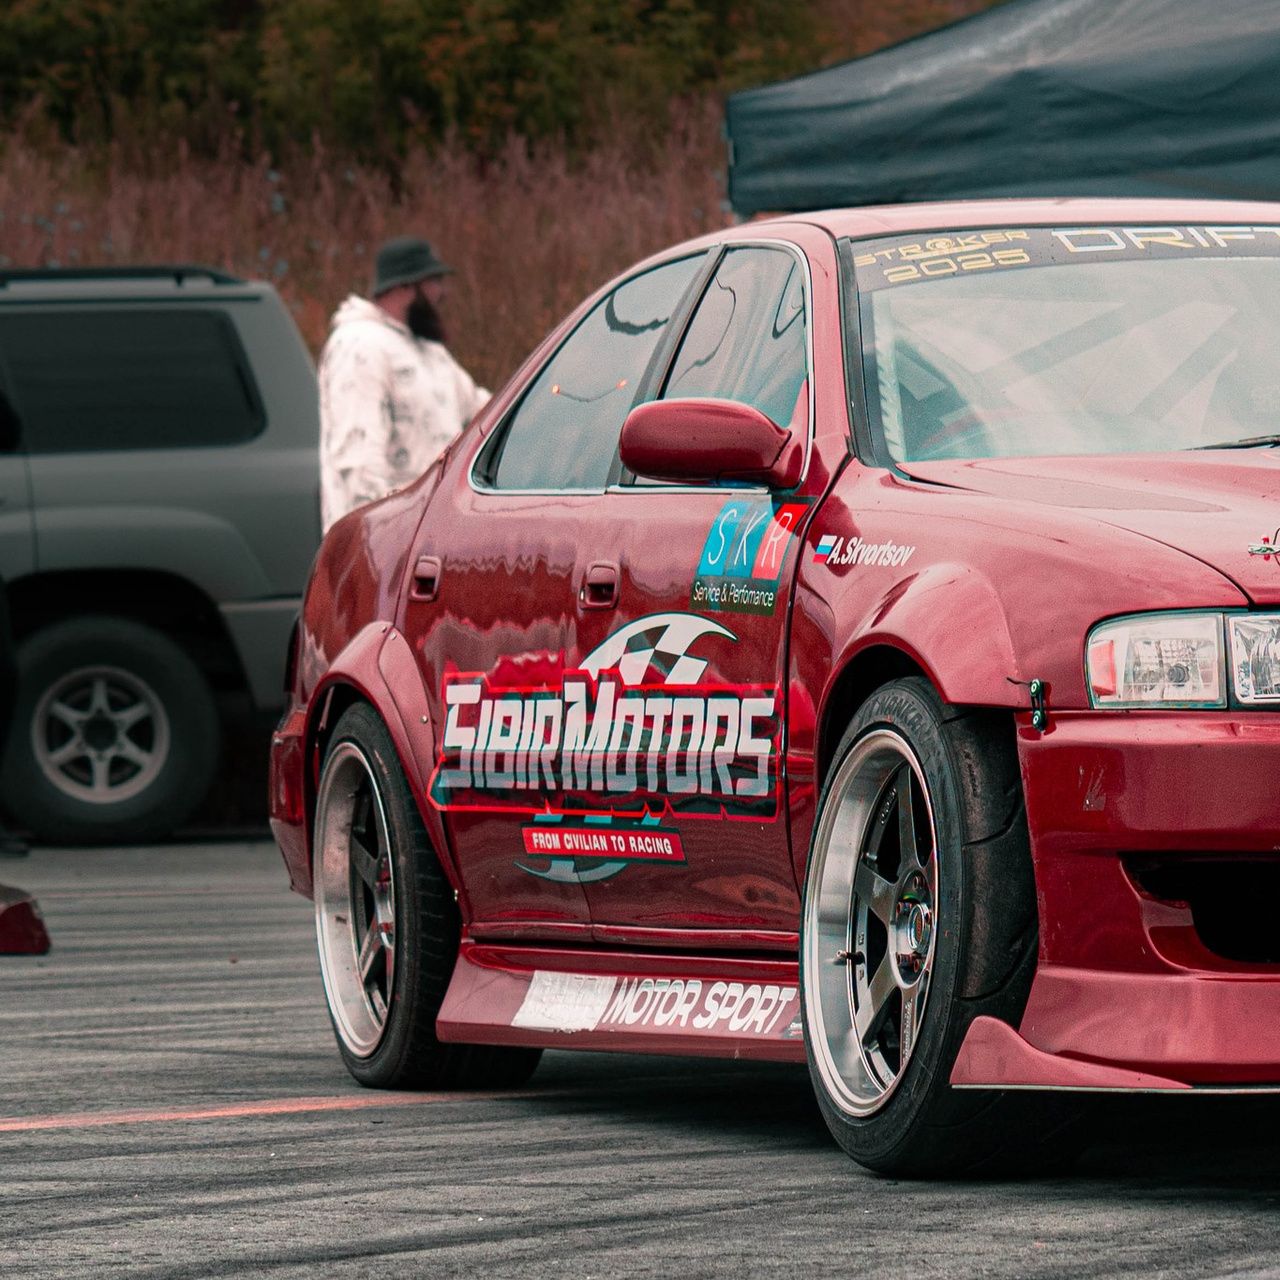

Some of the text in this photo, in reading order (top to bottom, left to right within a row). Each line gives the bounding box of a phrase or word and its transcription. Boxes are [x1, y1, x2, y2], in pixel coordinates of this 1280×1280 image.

[884, 249, 1031, 283] 2025
[708, 507, 793, 569] SKR
[827, 537, 916, 566] A.Skvortsov
[693, 581, 721, 603] Service
[532, 832, 673, 855] FROM CIVILIAN TO RACING
[602, 977, 797, 1034] MOTOR SPORT
